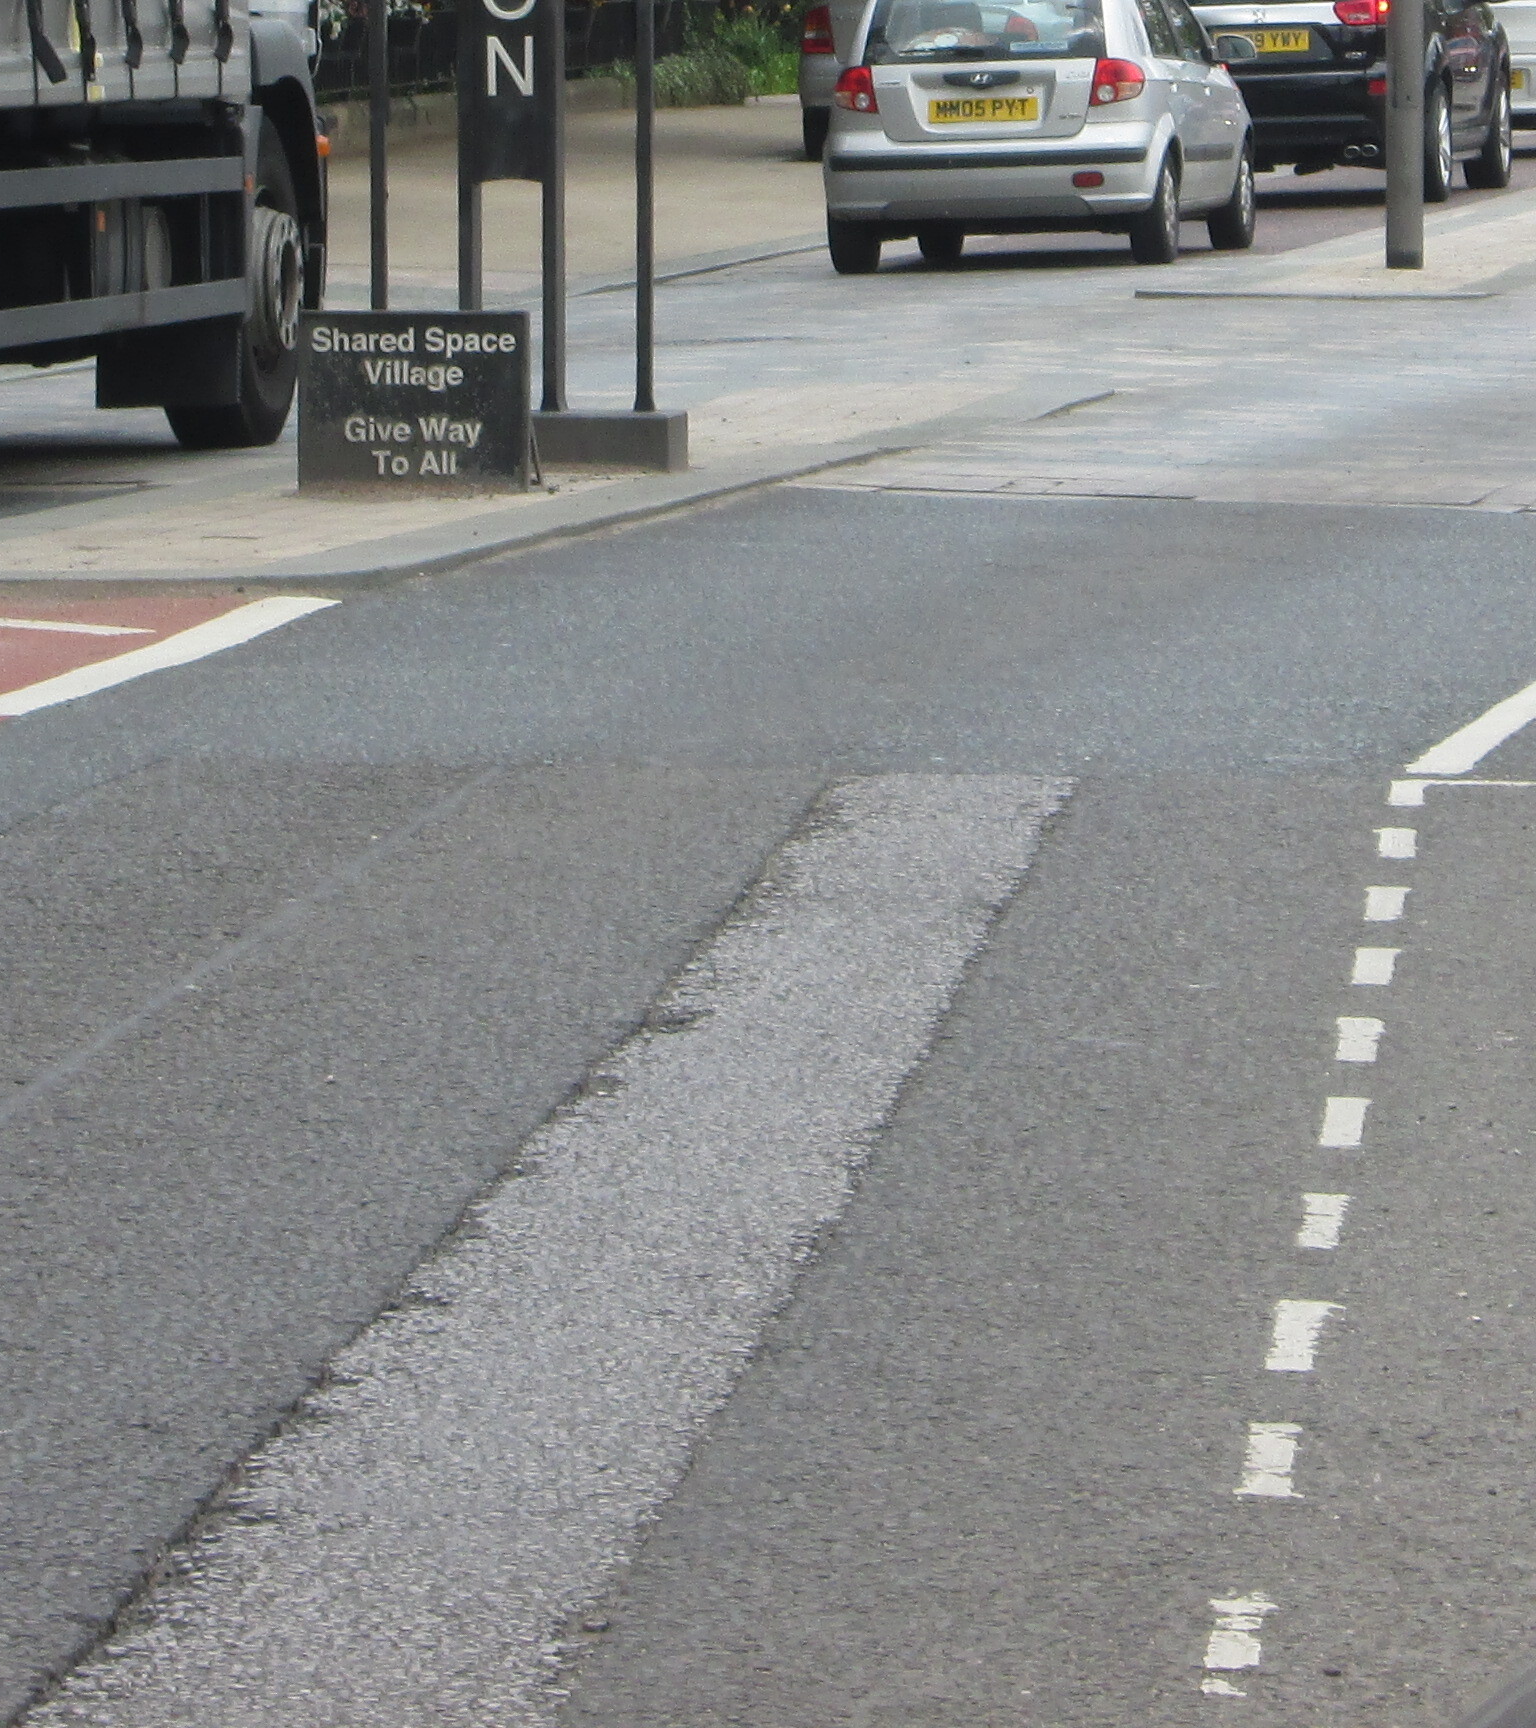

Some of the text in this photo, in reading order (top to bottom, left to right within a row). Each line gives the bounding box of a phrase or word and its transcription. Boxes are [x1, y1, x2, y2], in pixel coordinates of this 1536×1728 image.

[311, 326, 517, 359] Shared Space
[364, 360, 465, 392] Village
[344, 416, 483, 449] Give Way
[370, 450, 458, 476] To All
